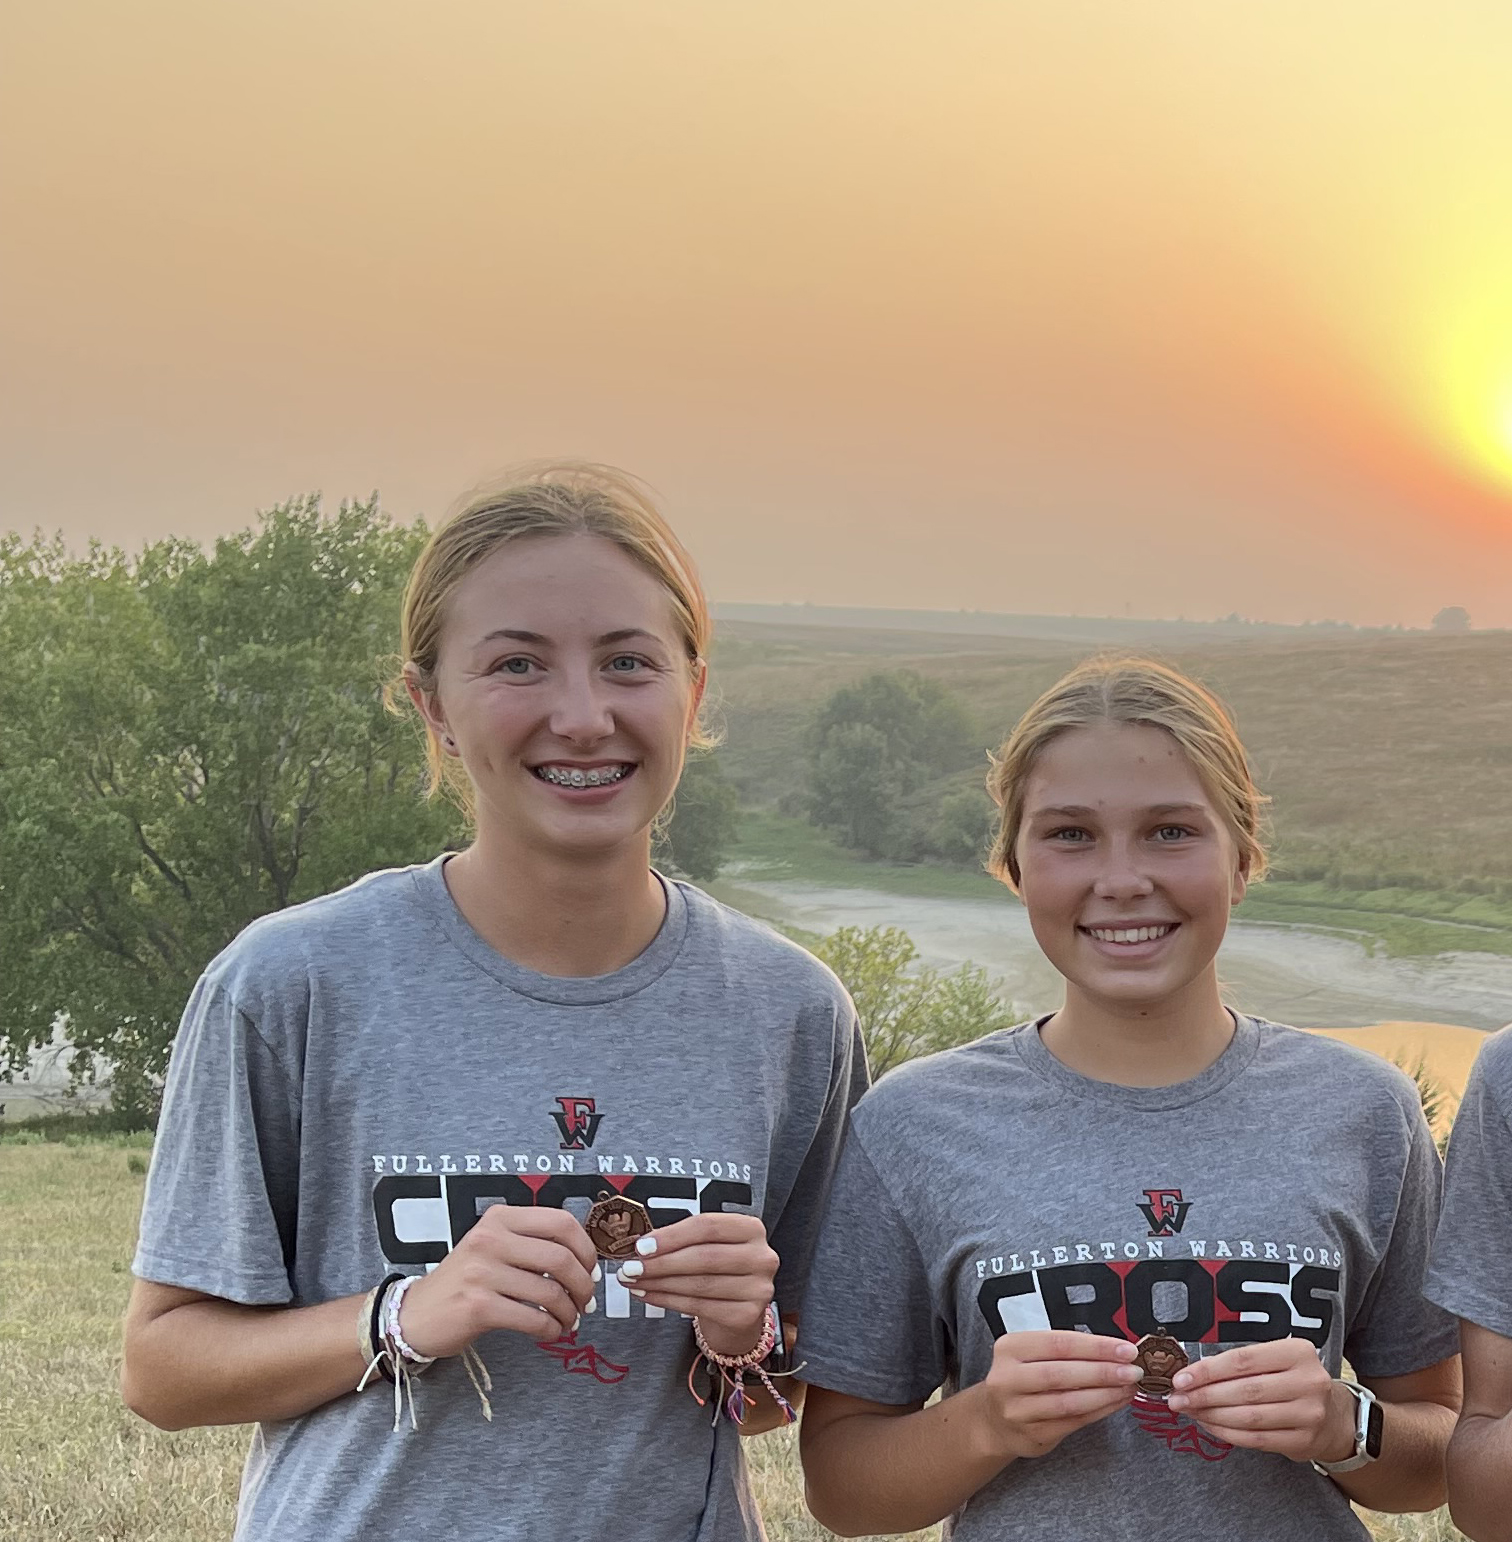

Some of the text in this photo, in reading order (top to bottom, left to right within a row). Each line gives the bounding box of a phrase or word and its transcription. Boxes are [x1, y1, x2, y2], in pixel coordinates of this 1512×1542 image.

[373, 1153, 752, 1182] FULLERTON WARRIORS
[976, 1240, 1342, 1279] FULLERTON WARRIORS
[977, 1259, 1341, 1347] CROSS
